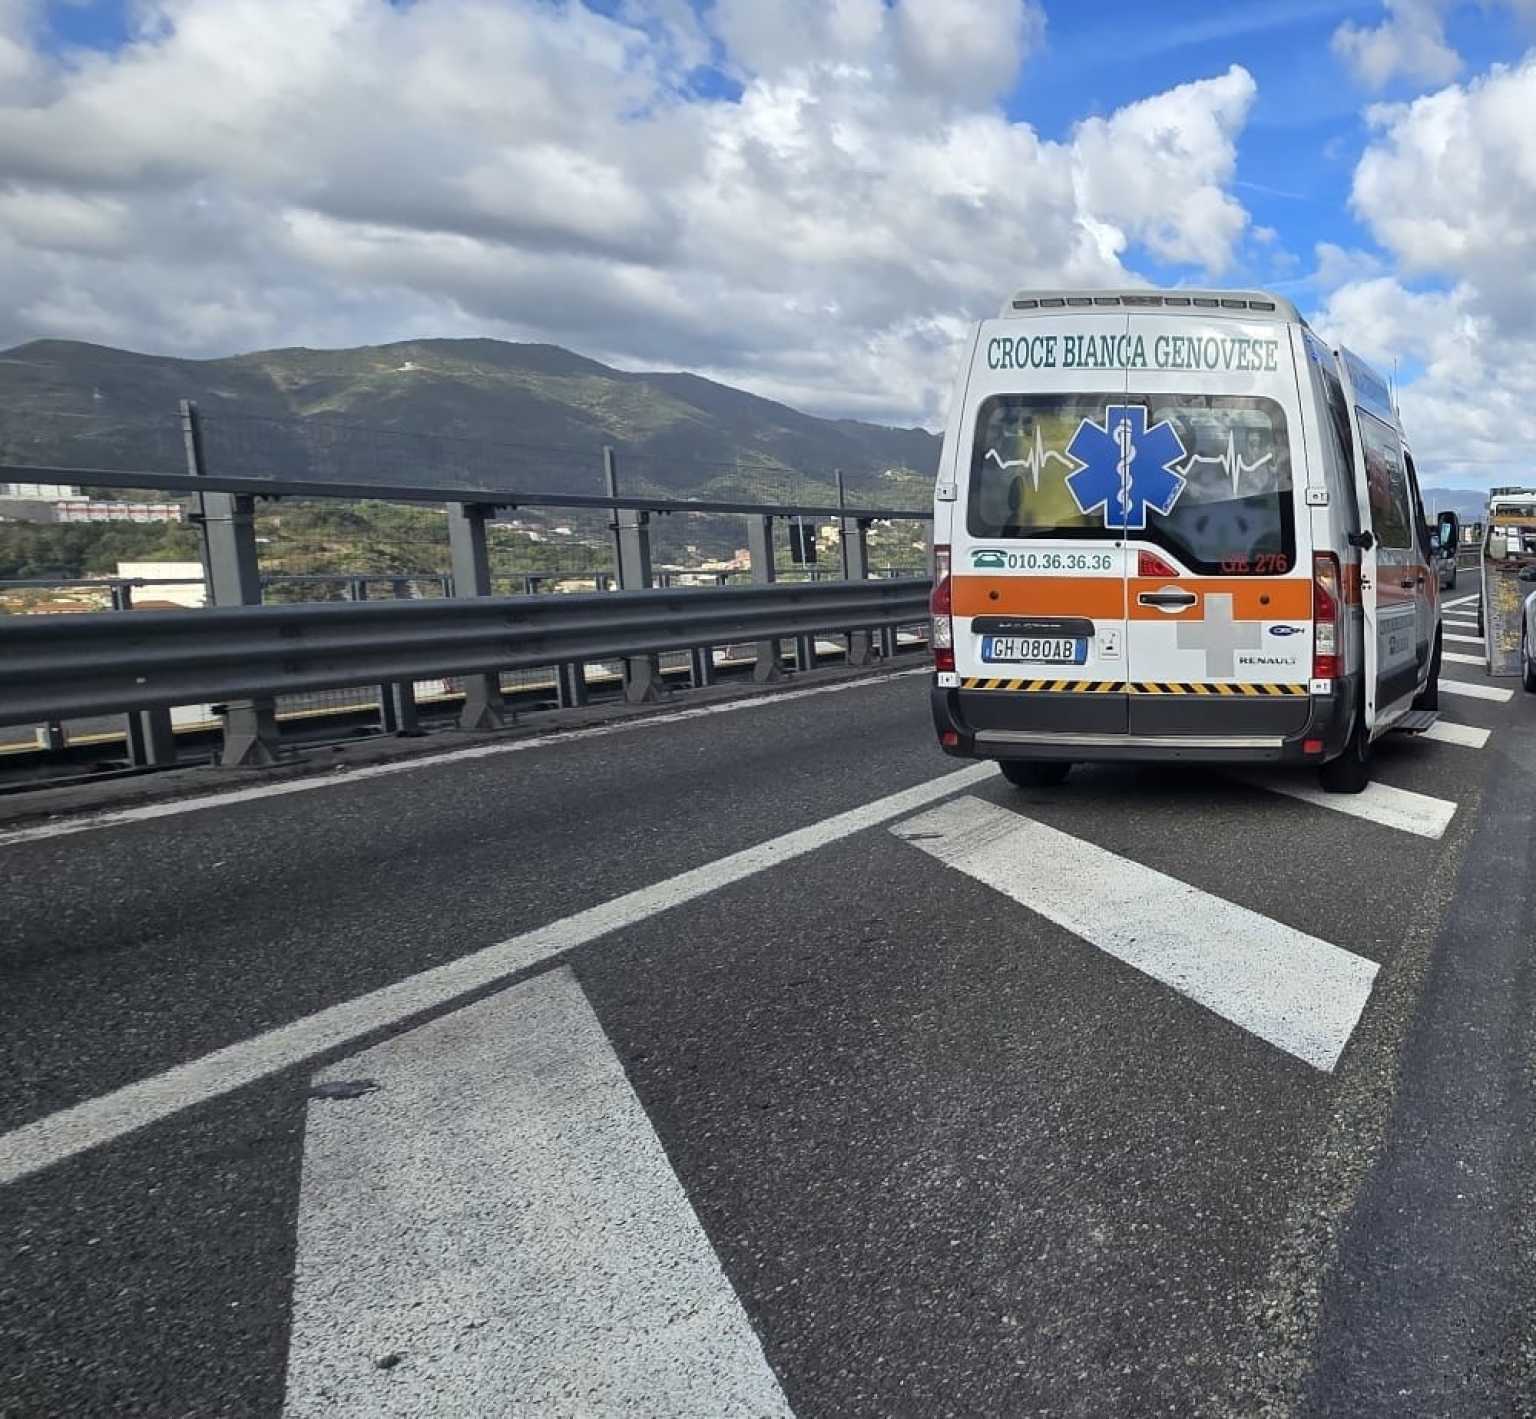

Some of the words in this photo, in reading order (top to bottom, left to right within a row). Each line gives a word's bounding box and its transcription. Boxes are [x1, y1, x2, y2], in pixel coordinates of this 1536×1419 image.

[987, 335, 1058, 370] CROCE
[1062, 334, 1148, 369] BIANCA
[1154, 336, 1279, 372] GENOVESE
[1008, 553, 1113, 570] 010.36.36.36
[1221, 554, 1249, 572] GE
[1255, 553, 1288, 573] 276
[993, 640, 1015, 658] GH
